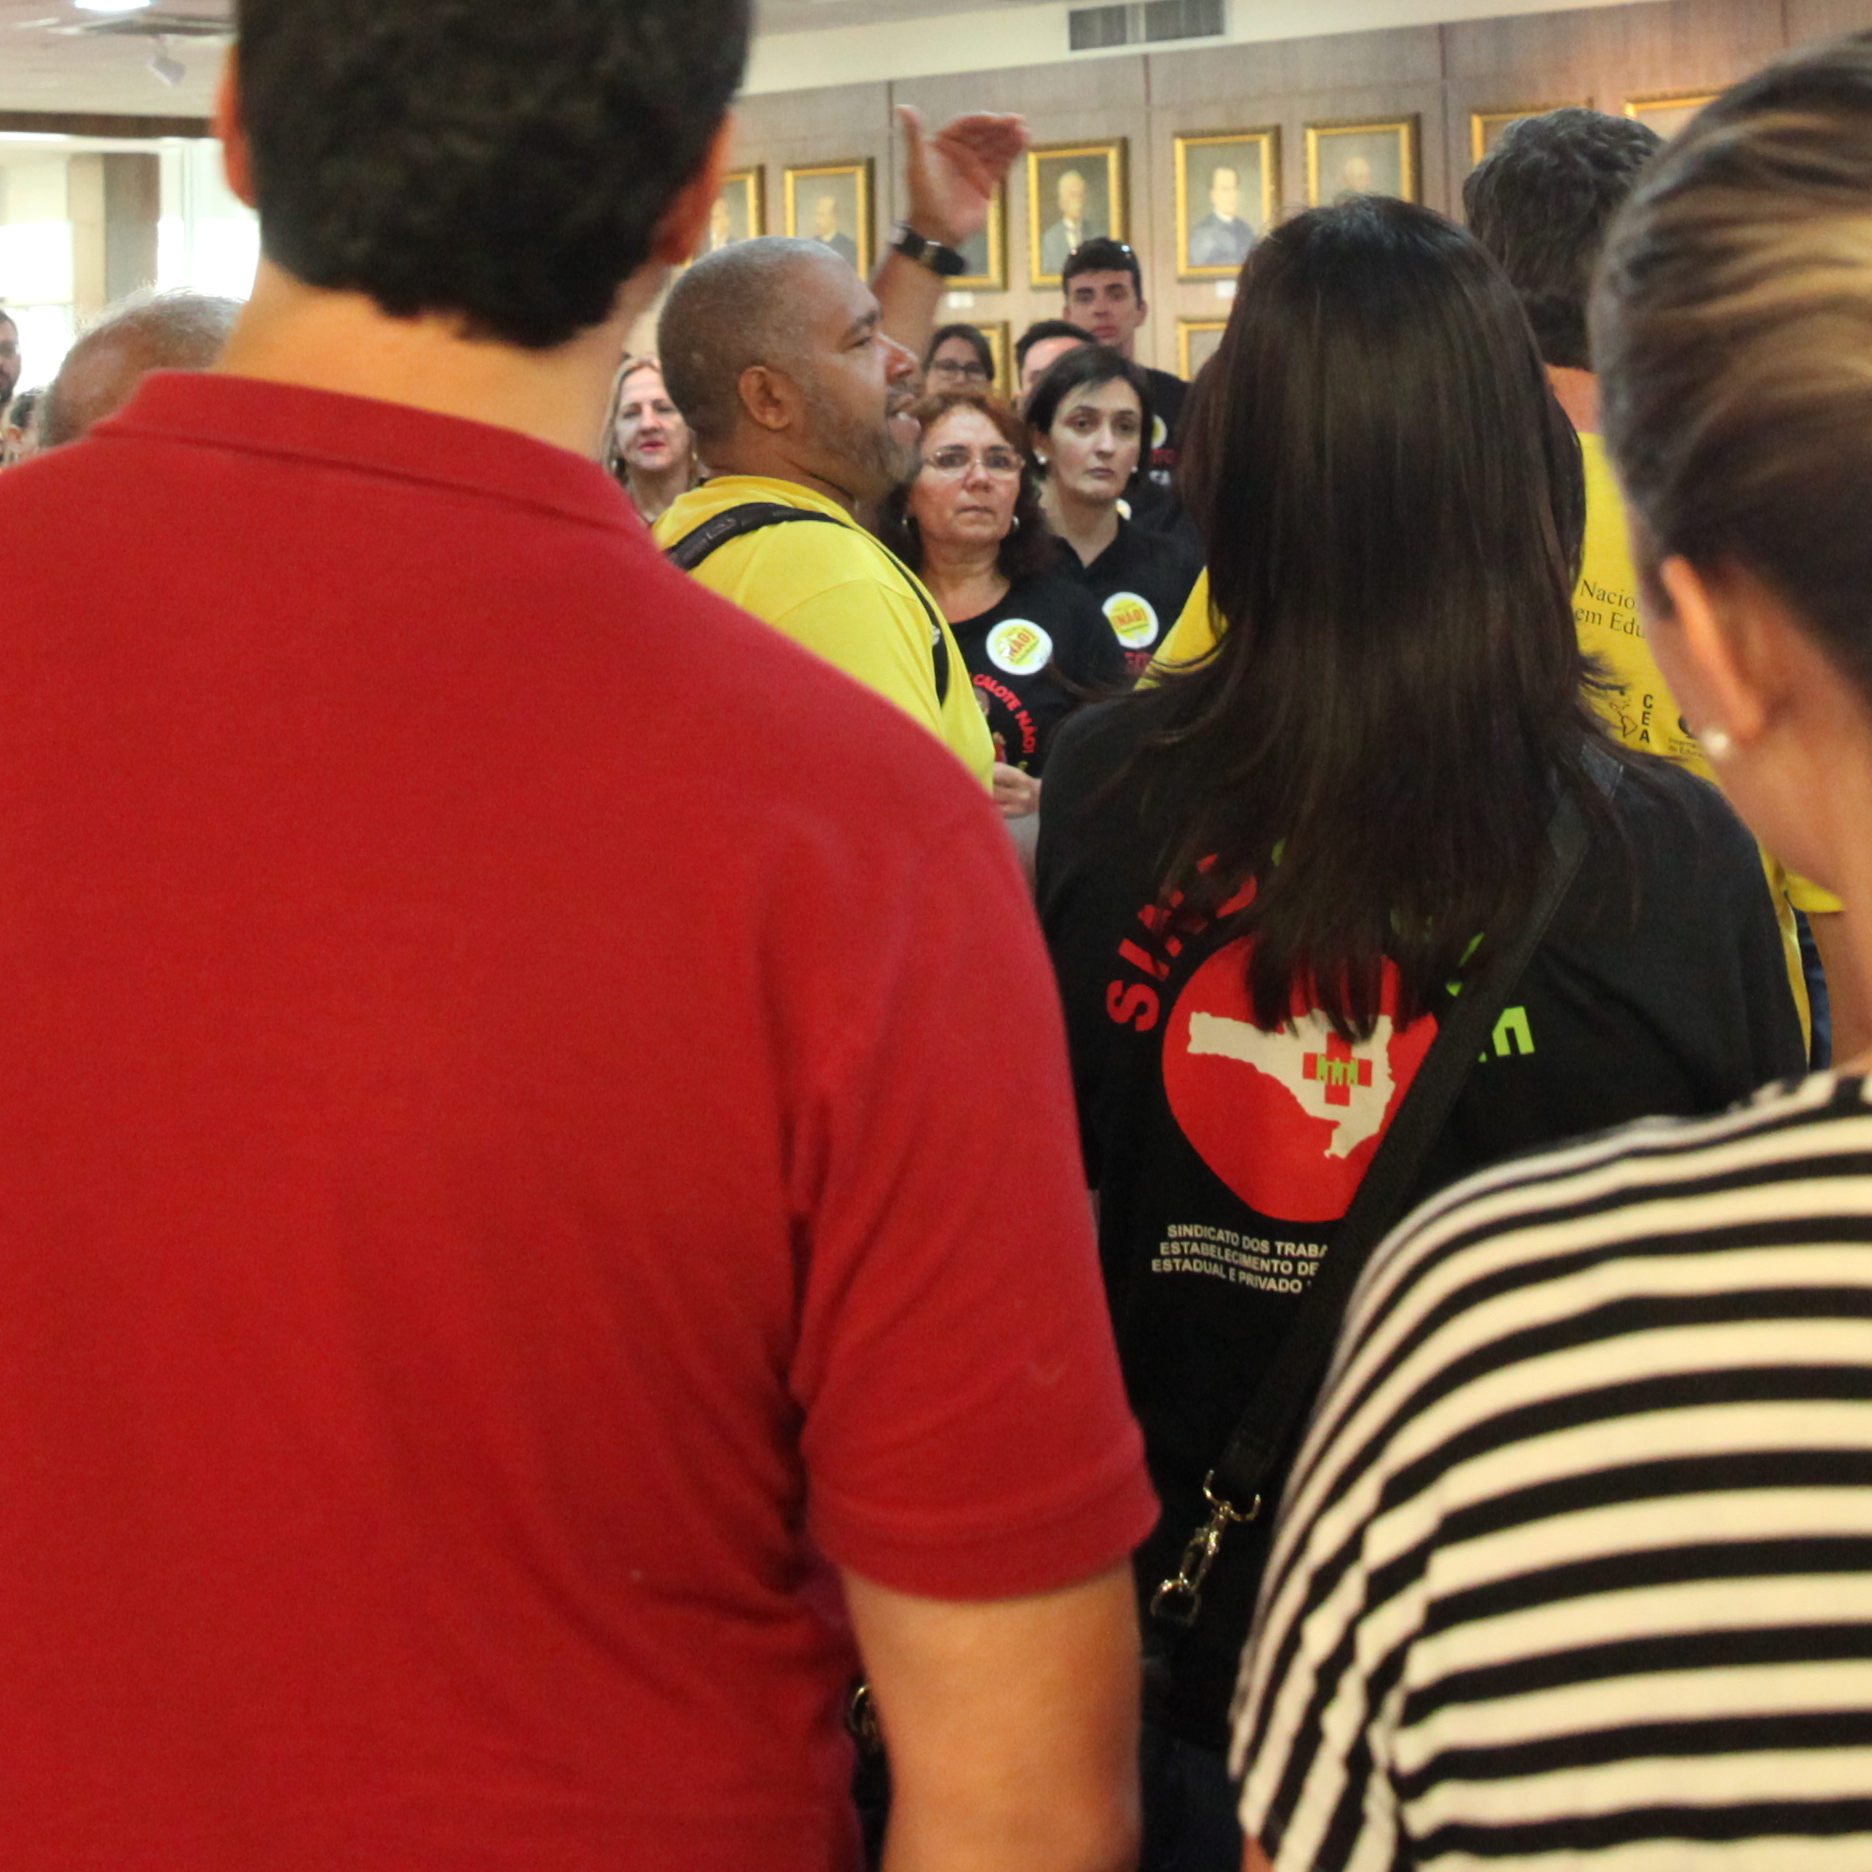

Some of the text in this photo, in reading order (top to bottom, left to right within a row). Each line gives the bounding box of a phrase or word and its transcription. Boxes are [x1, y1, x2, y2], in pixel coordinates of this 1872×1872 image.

[1167, 1224, 1239, 1247] SINDICATO
[1242, 1235, 1270, 1254] DOS
[1151, 1258, 1303, 1294] ESTADUAL E PRIVADO
[1159, 1241, 1293, 1276] ESTABELECIMENTO
